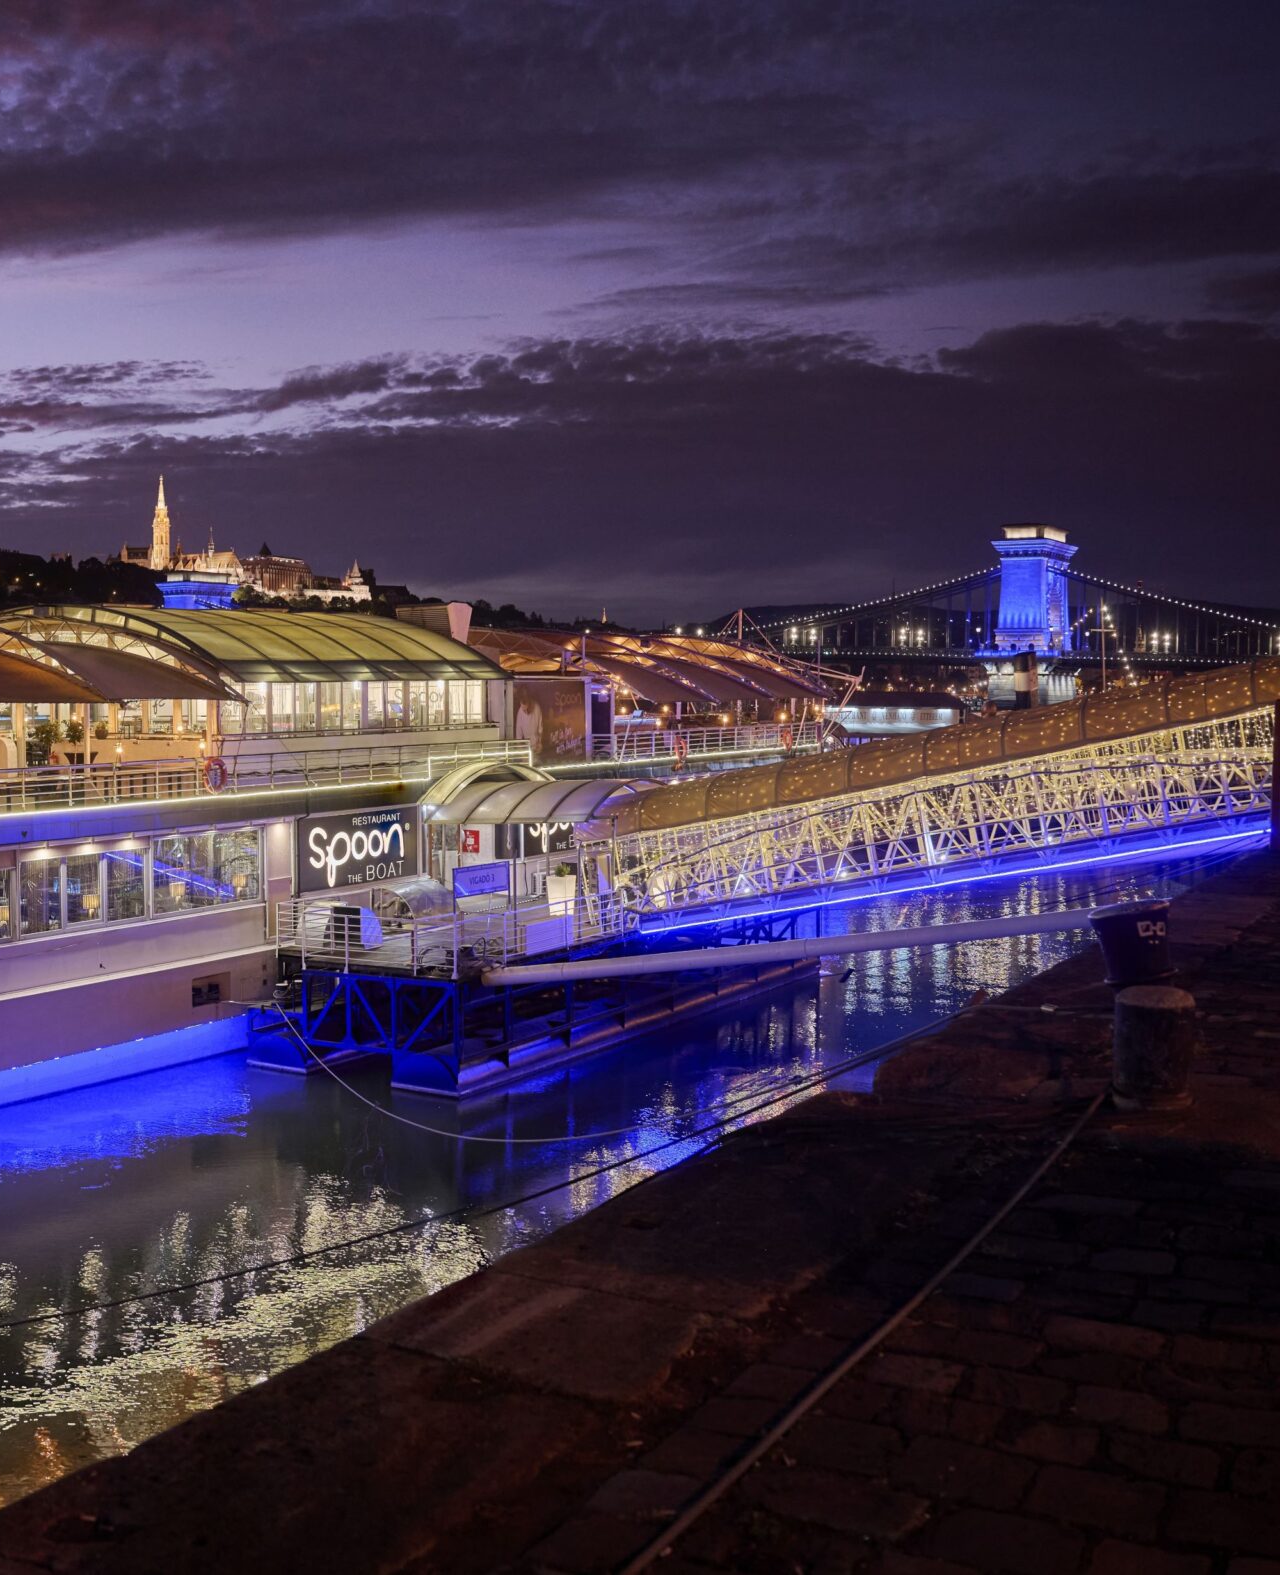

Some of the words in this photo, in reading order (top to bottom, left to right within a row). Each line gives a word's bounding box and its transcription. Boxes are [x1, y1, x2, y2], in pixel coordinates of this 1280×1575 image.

[352, 812, 401, 826] RESTAURANT
[308, 822, 405, 888] Spoon
[556, 842, 568, 850] THE
[347, 873, 363, 883] THE
[365, 860, 405, 881] BOAT
